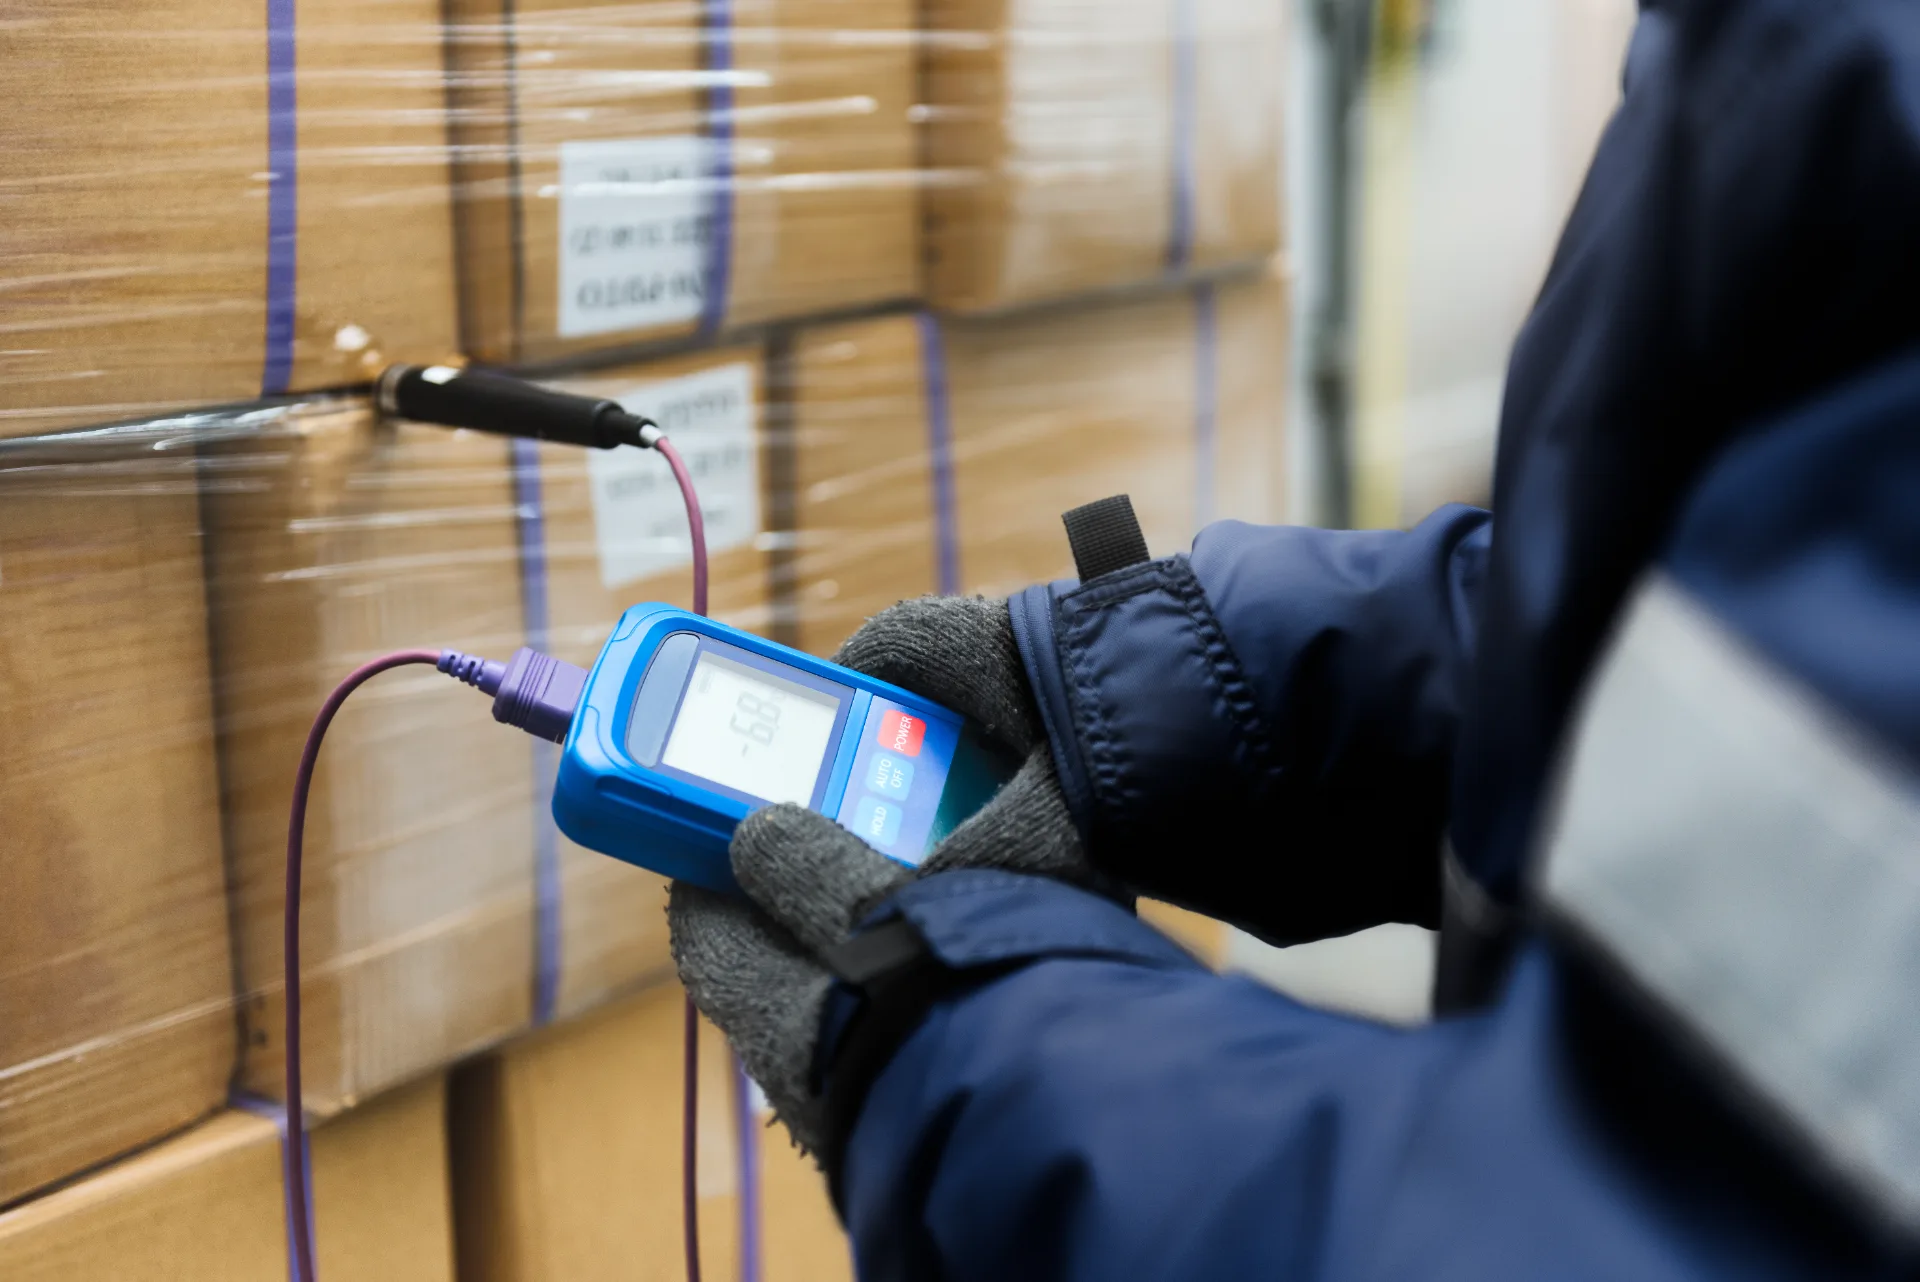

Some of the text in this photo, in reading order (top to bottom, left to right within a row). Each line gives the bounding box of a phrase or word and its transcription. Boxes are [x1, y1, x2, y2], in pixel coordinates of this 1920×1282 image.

[894, 716, 912, 752] POWER
[876, 758, 892, 789] AUTO
[890, 768, 905, 789] OFF
[871, 806, 887, 836] HOLD
